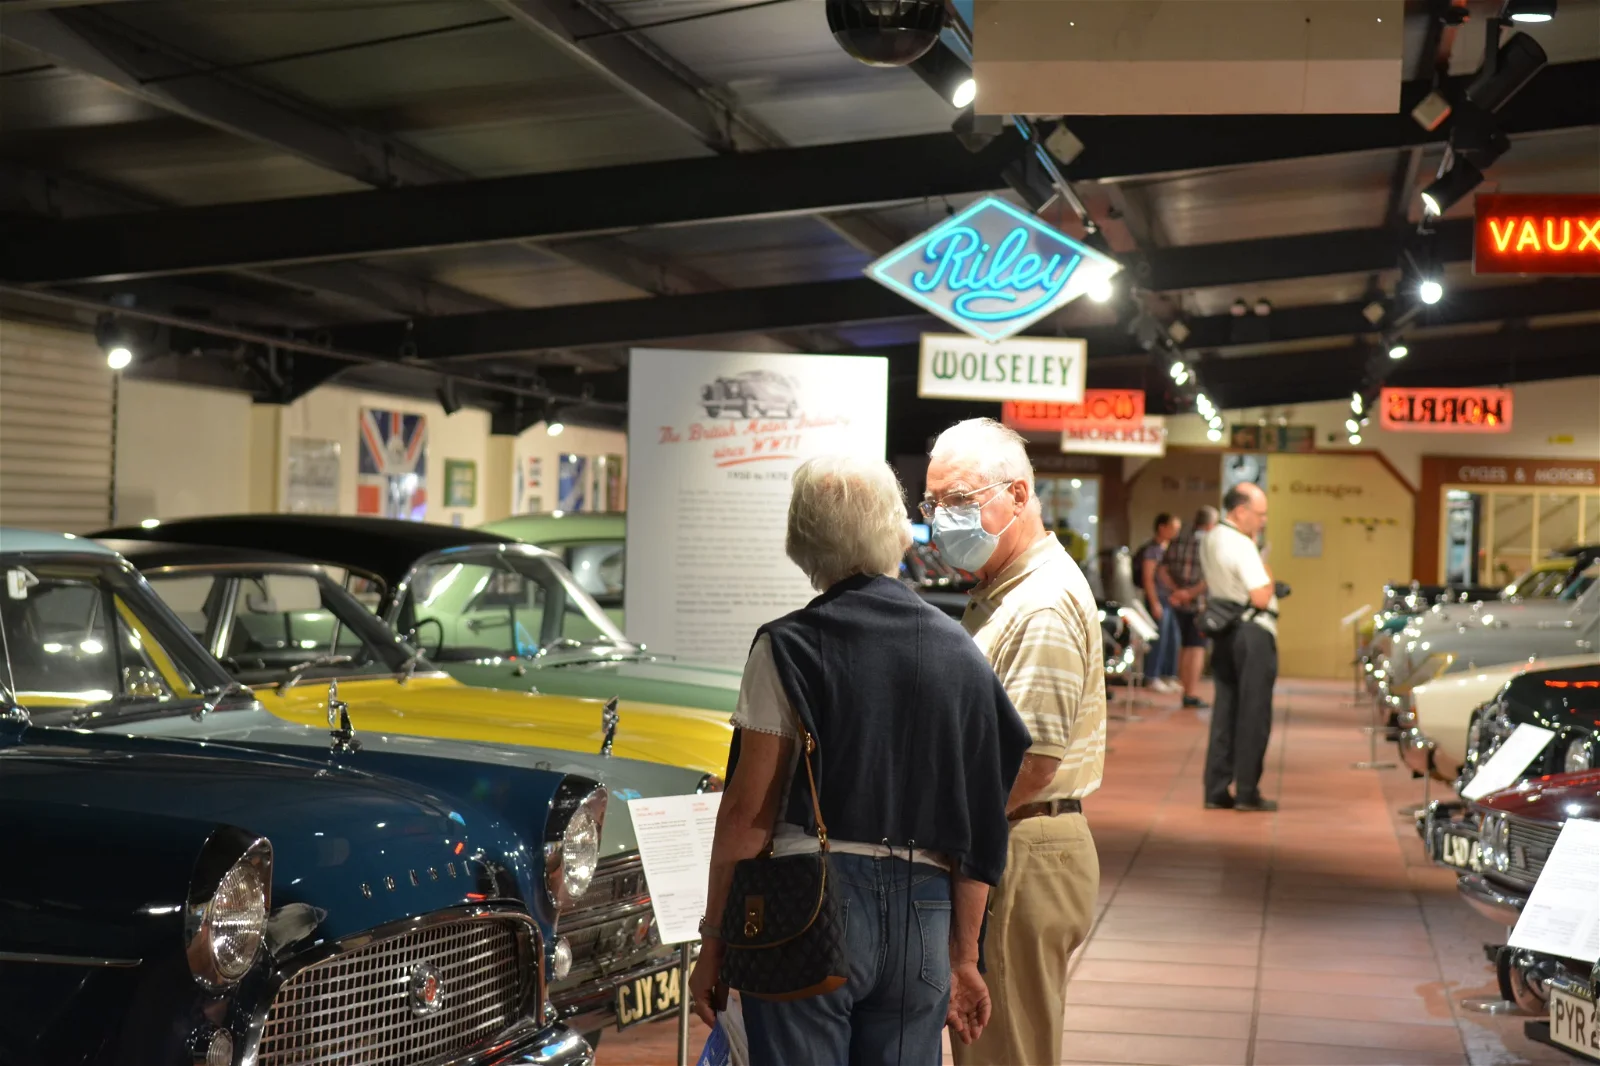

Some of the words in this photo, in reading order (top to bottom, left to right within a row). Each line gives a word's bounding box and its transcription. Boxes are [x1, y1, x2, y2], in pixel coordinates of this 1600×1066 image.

[1489, 218, 1600, 252] VAUX
[913, 226, 1081, 320] Riley
[931, 350, 1073, 387] WOLSELEY
[658, 426, 681, 445] The
[689, 421, 736, 441] British
[1458, 466, 1507, 483] CYCLES
[1514, 467, 1526, 482] &
[1534, 467, 1595, 484] MOTORS
[619, 975, 653, 1025] CJY
[1556, 998, 1586, 1046] PYR
